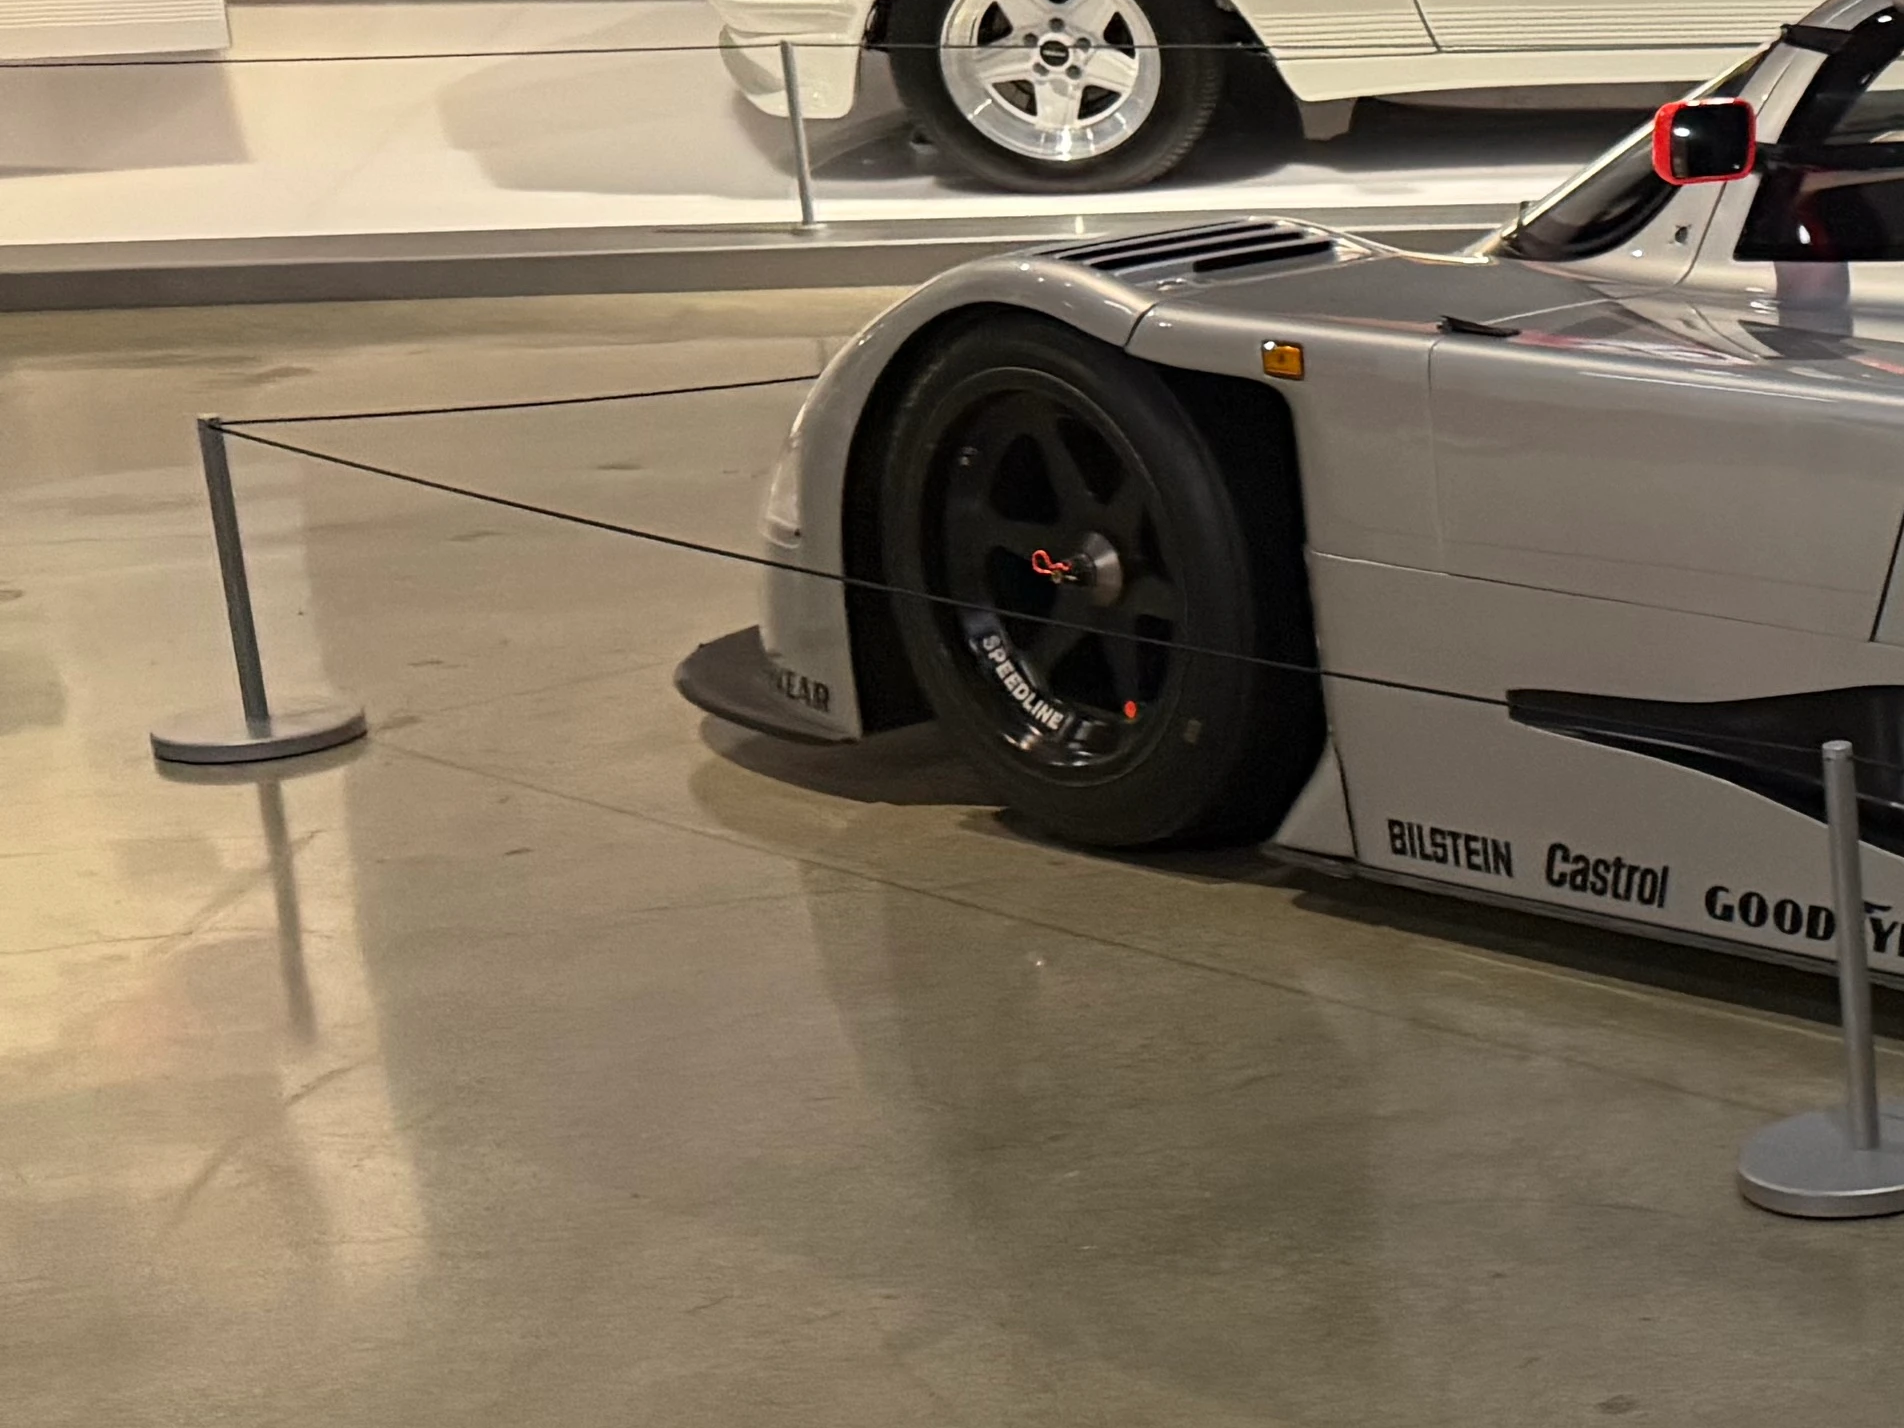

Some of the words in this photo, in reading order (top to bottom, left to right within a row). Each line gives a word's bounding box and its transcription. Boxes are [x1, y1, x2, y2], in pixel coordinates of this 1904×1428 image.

[982, 635, 1064, 730] SPEEDLINE
[1387, 818, 1514, 878] BILSTEIN
[1545, 842, 1669, 909] Castrol
[1704, 885, 1836, 942] GOOD
